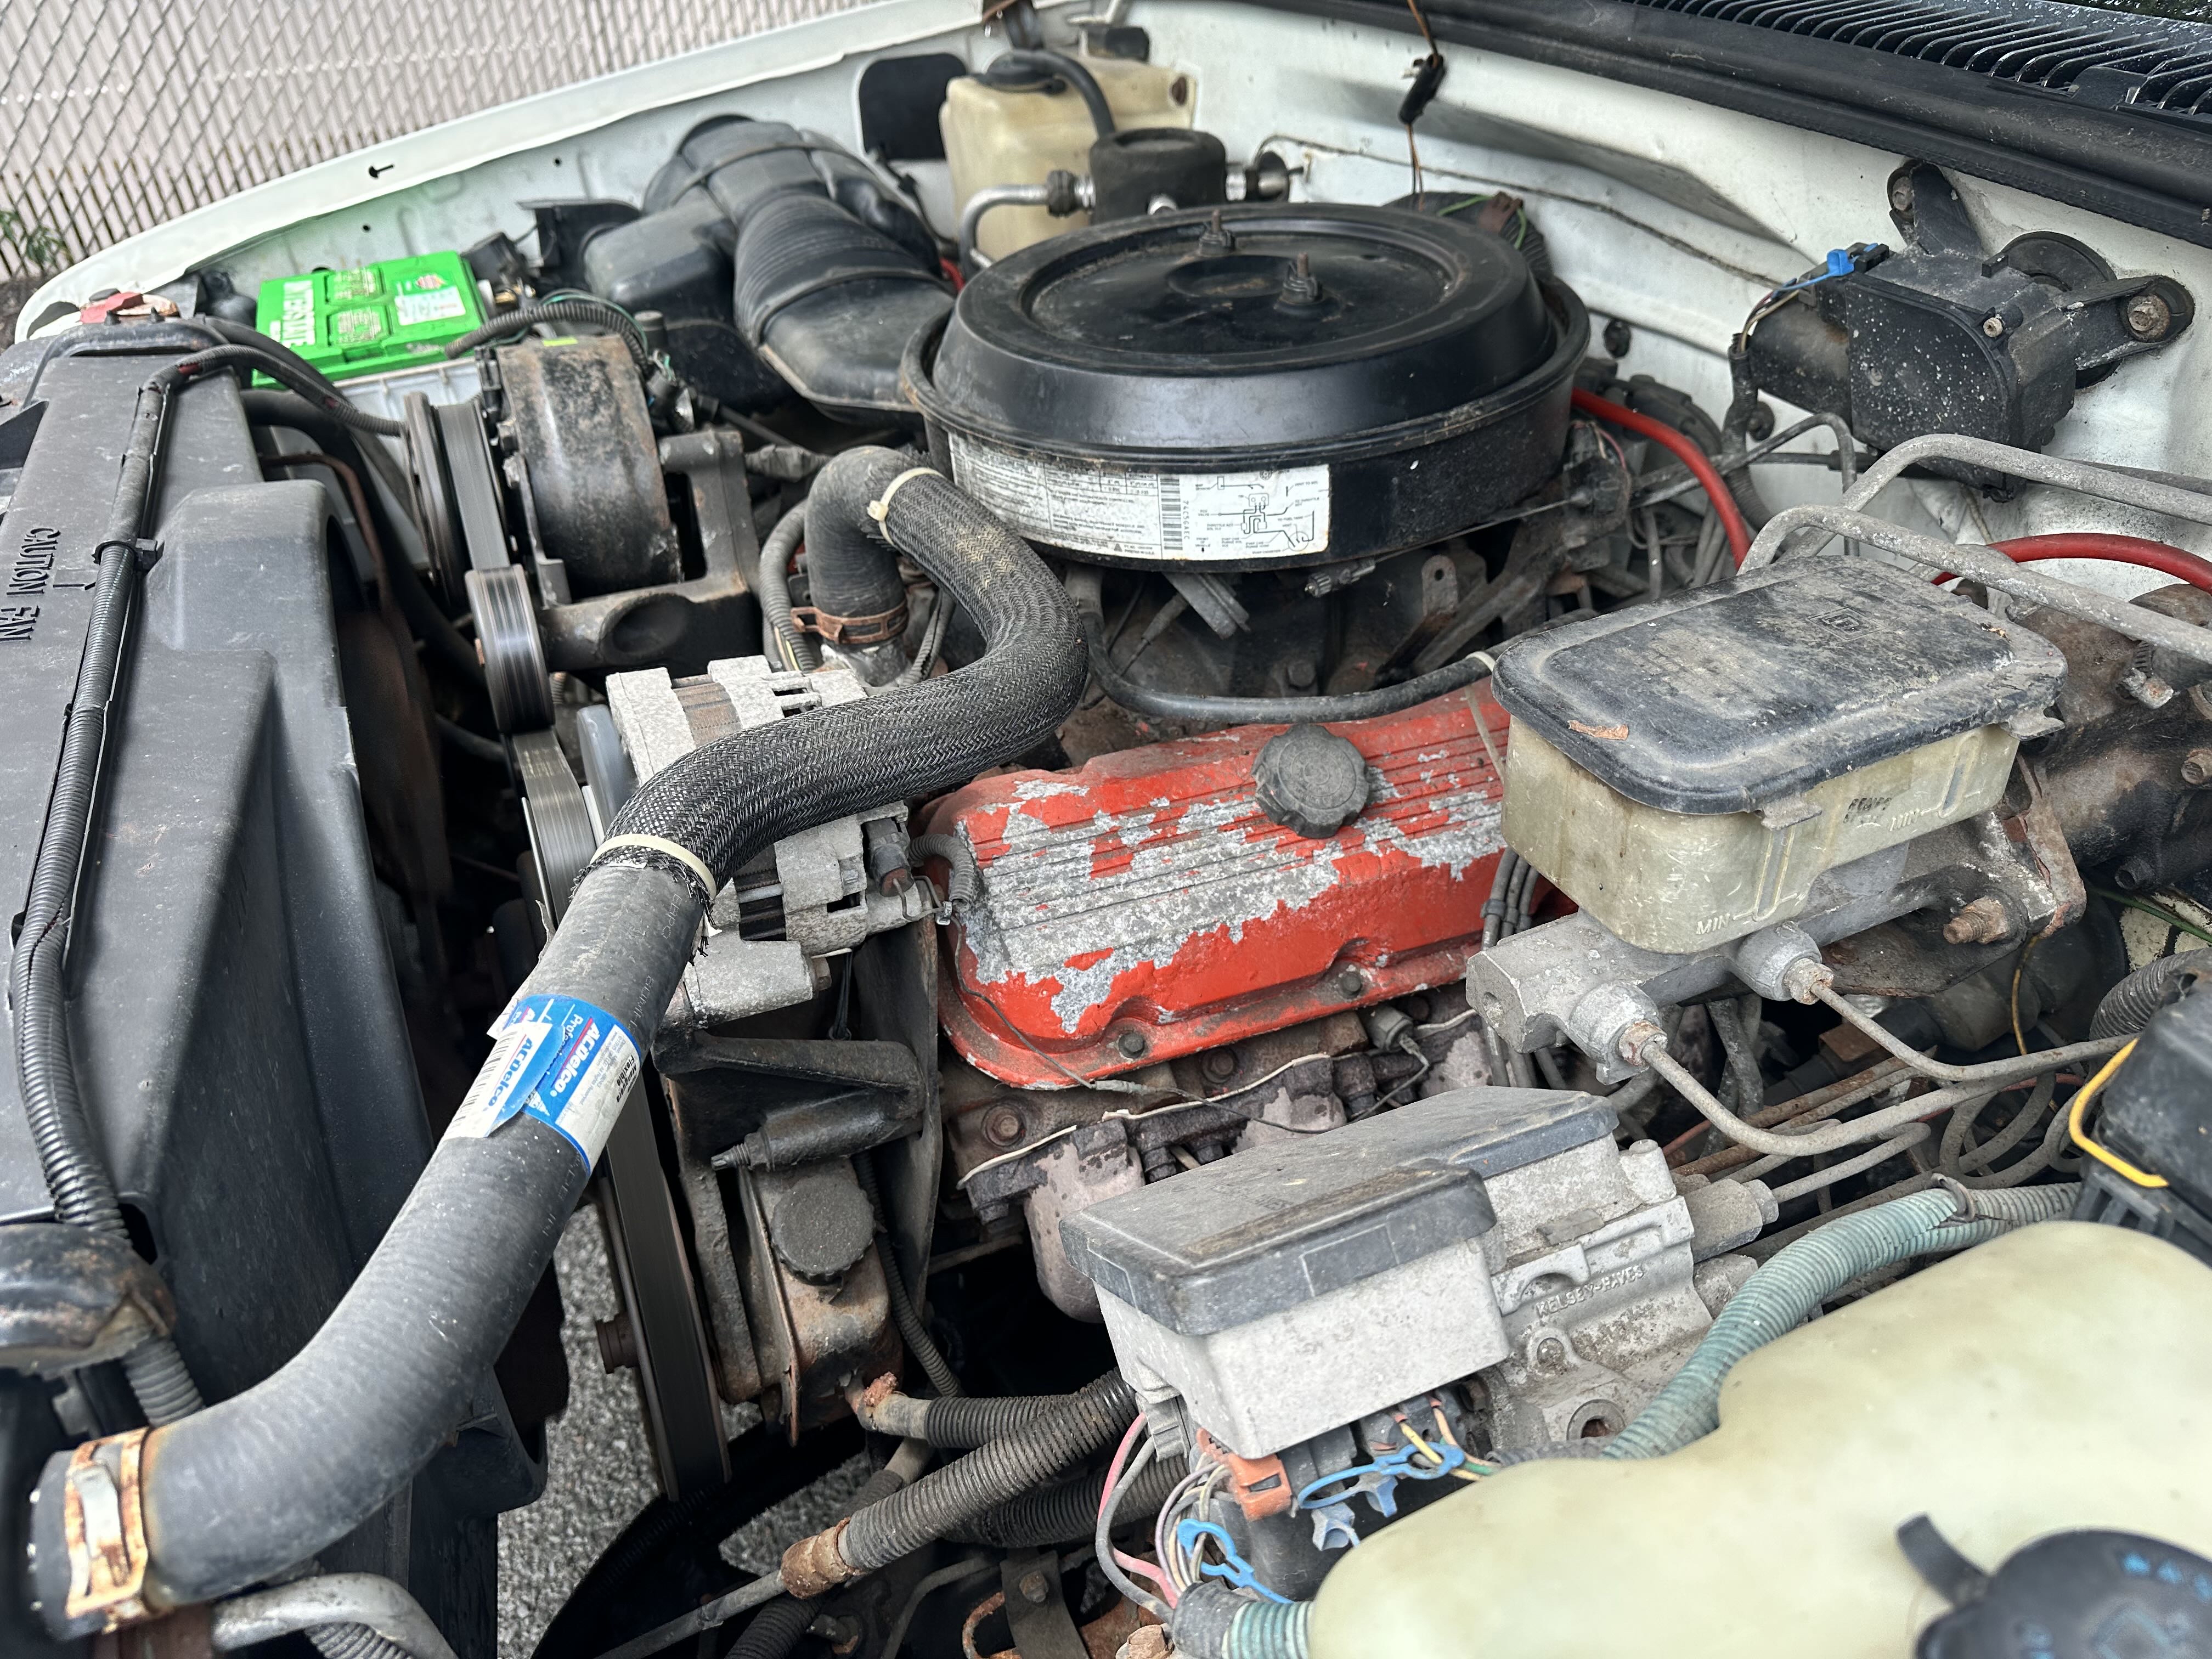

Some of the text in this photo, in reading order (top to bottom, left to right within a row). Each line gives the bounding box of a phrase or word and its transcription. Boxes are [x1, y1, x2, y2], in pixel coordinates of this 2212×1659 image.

[0, 528, 61, 641] CAUTION FAN
[1696, 912, 1730, 934] MIN
[617, 1054, 635, 1086] Flexible
[1536, 1265, 1645, 1317] KELSEY-HAYES
